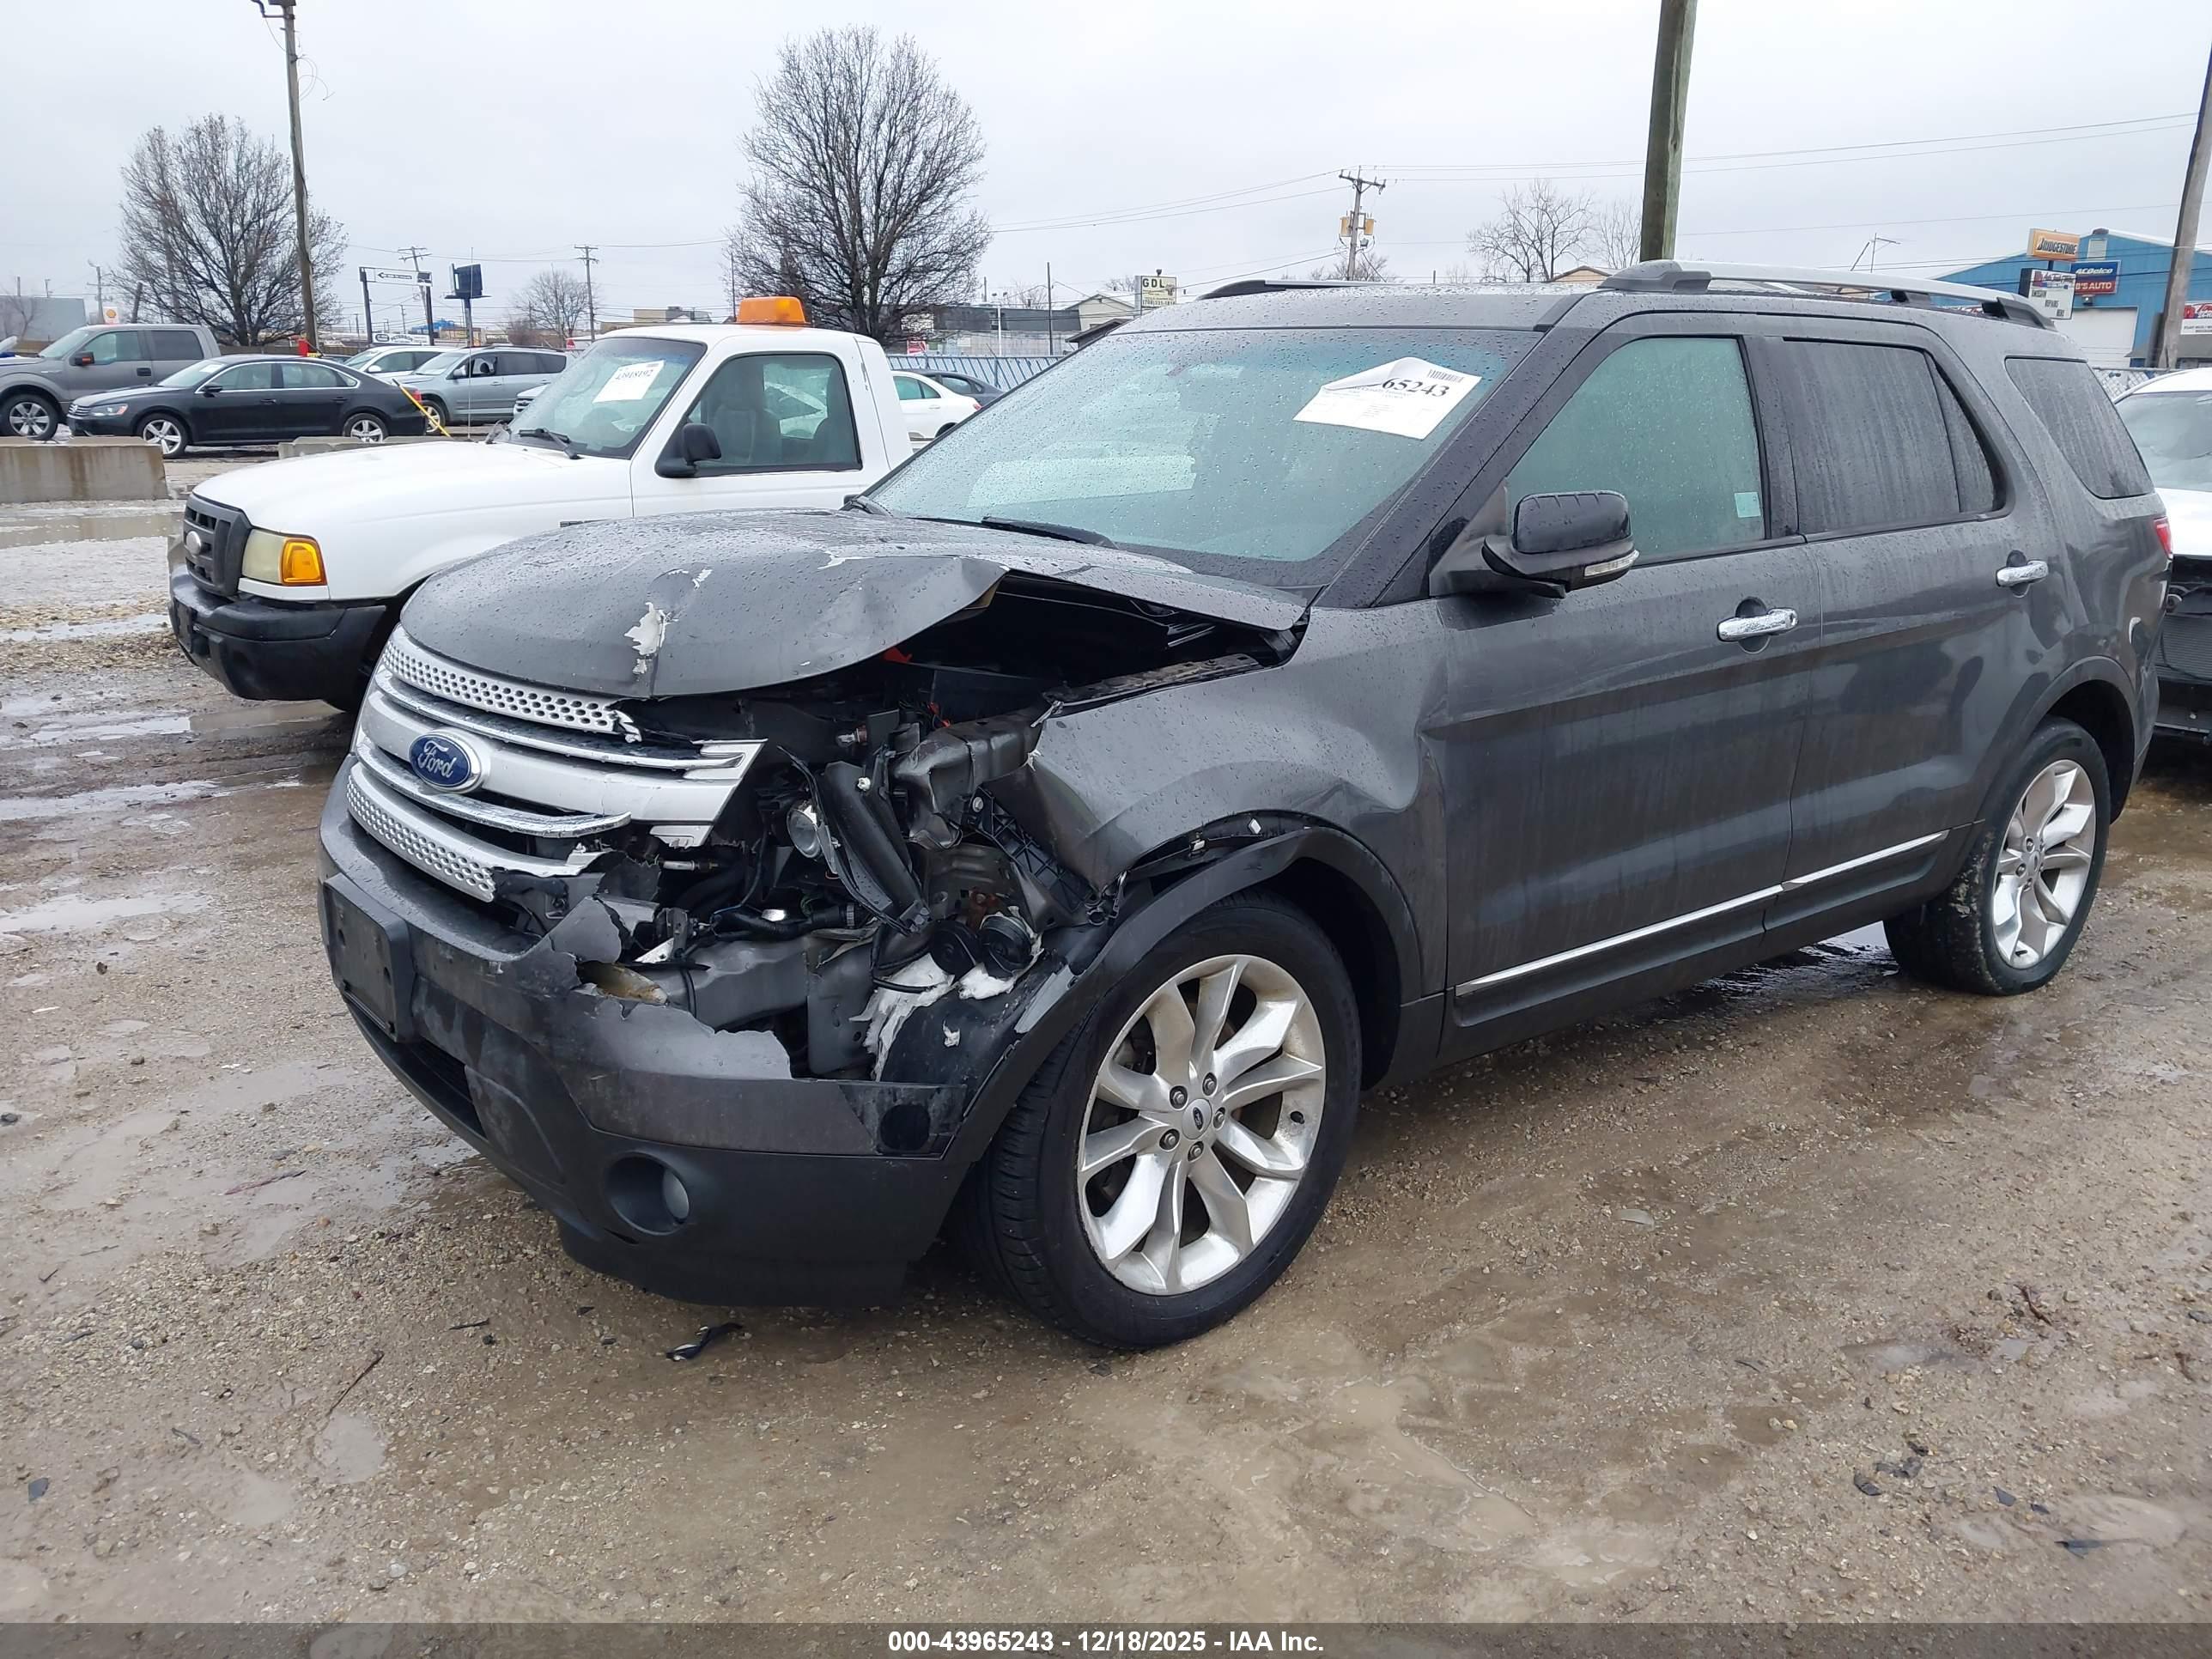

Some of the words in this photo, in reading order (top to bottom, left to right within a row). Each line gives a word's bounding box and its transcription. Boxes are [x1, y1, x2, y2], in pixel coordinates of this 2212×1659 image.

[1142, 278, 1164, 288] GDL
[1382, 378, 1449, 397] 65243
[416, 740, 457, 778] Ford
